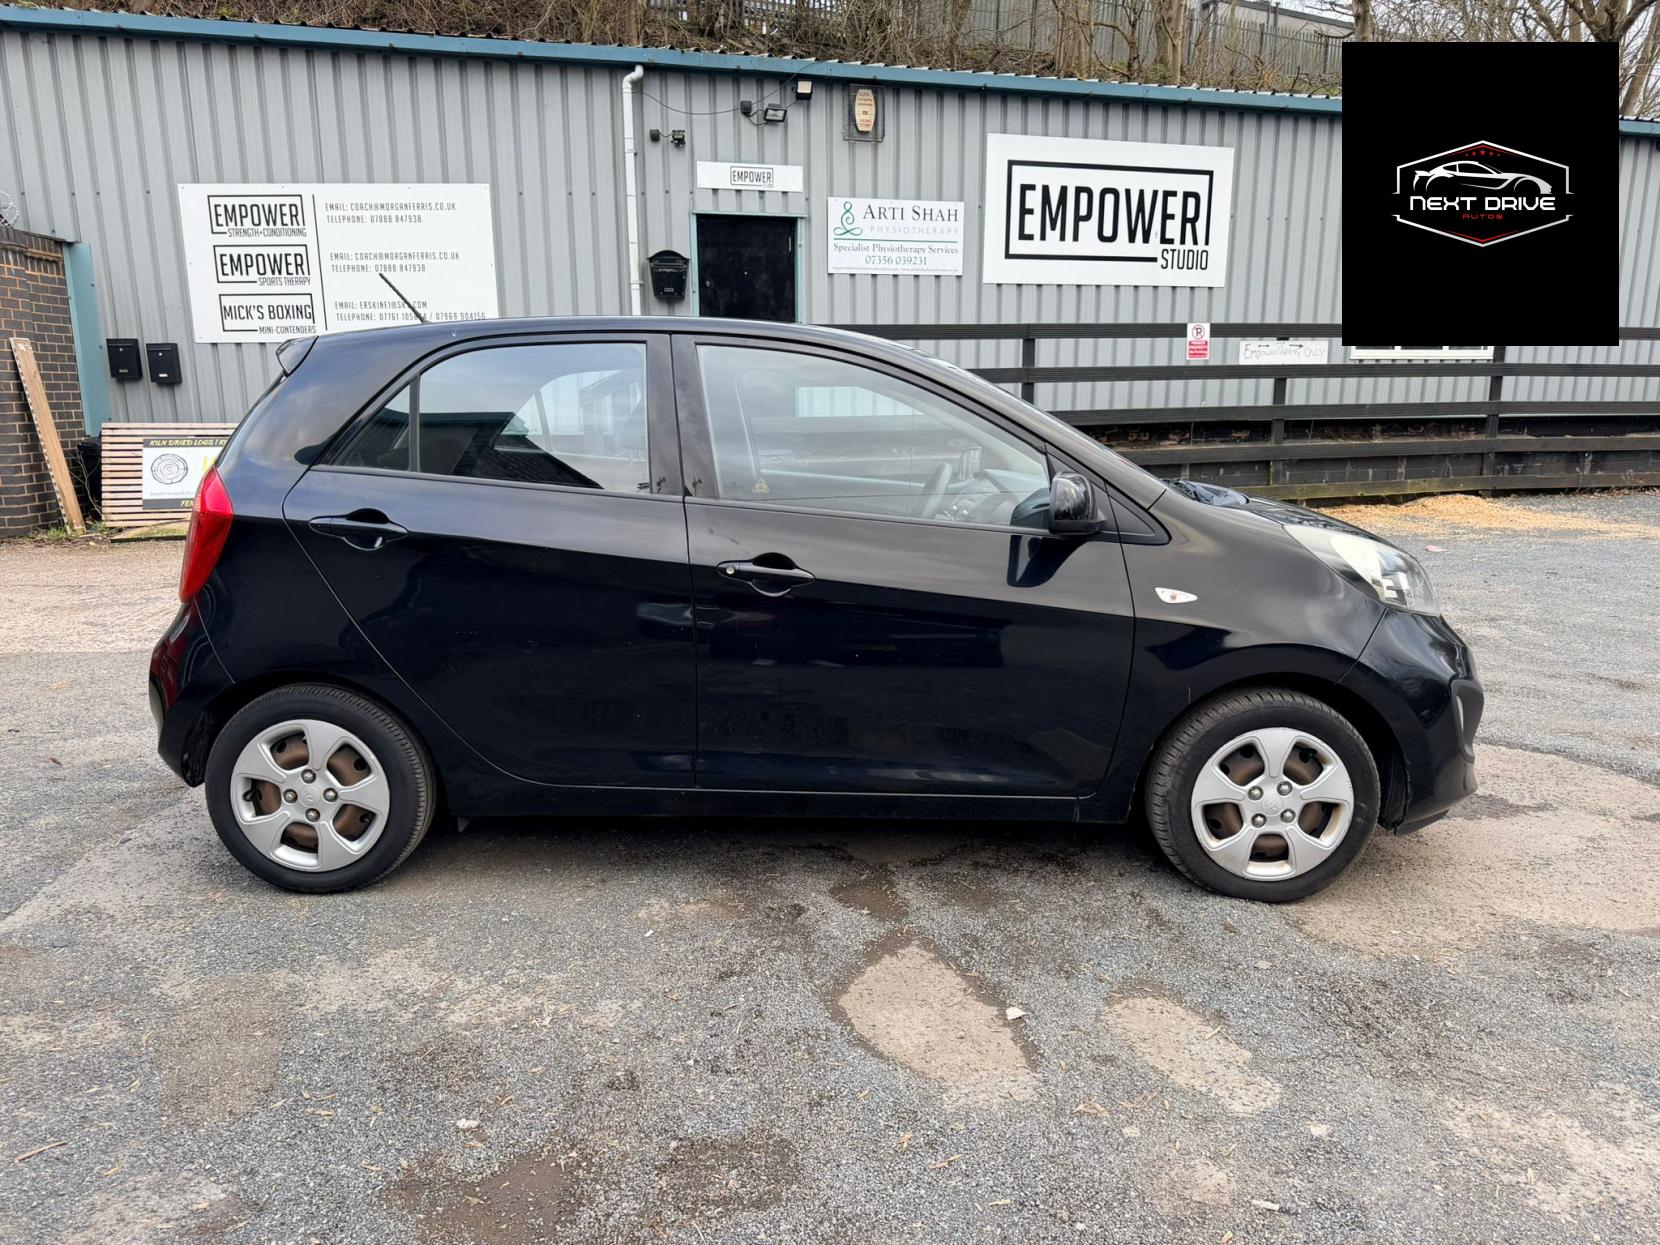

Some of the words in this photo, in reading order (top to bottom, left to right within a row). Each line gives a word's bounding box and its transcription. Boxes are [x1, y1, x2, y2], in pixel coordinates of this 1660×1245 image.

[732, 170, 772, 183] EMPOWER
[325, 203, 349, 211] EMAIL:
[214, 203, 300, 227] EMPOWER
[862, 204, 905, 220] ARTI
[911, 205, 958, 222] SHAH
[1018, 183, 1201, 246] EMPOWER
[326, 215, 368, 224] TELEPHONE:
[870, 225, 959, 235] PHYSIOTHERAPY
[833, 242, 870, 253] Specialist
[872, 243, 926, 255] Physiotherapy
[927, 245, 959, 255] Services
[330, 252, 353, 261] EMAIL:
[865, 255, 894, 265] 07356
[895, 256, 927, 265] 039231
[1160, 248, 1209, 271] STUDIO
[219, 253, 305, 277] EMPOWER
[331, 264, 372, 273] TELEPHONE:
[258, 276, 283, 286] SPORTS
[283, 276, 311, 286] THERAPY
[335, 301, 358, 310] EMAIL:
[223, 304, 265, 320] MICK'S
[267, 304, 312, 320] BOXING
[336, 312, 377, 321] TELEPHONE:
[259, 325, 317, 335] MINI-CONTENDERS
